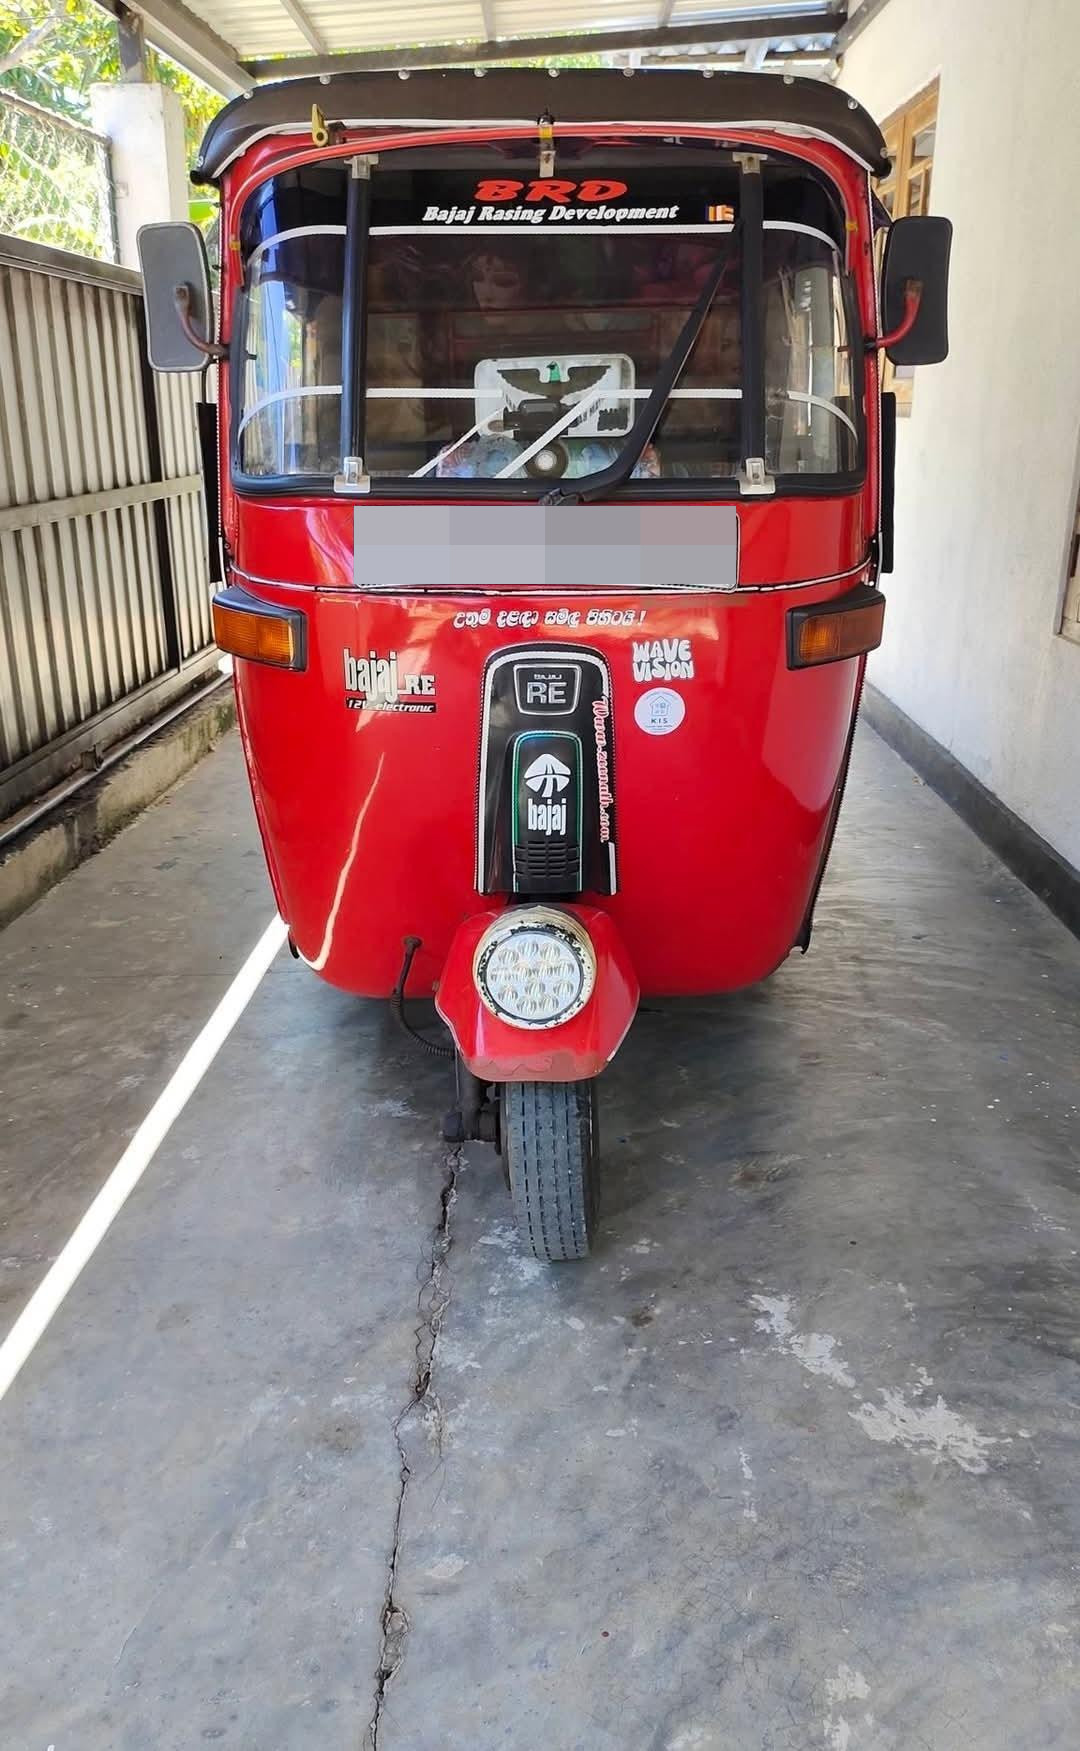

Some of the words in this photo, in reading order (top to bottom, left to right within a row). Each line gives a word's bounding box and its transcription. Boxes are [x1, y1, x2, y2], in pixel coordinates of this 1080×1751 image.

[473, 179, 629, 203] BRD
[422, 205, 476, 224] Bajaj
[477, 205, 546, 223] Rasing
[548, 204, 680, 222] Development
[632, 638, 692, 663] WAVE
[343, 647, 398, 704] bajaj
[632, 657, 695, 682] VISION
[526, 681, 568, 705] RE
[527, 797, 567, 836] bajaj
